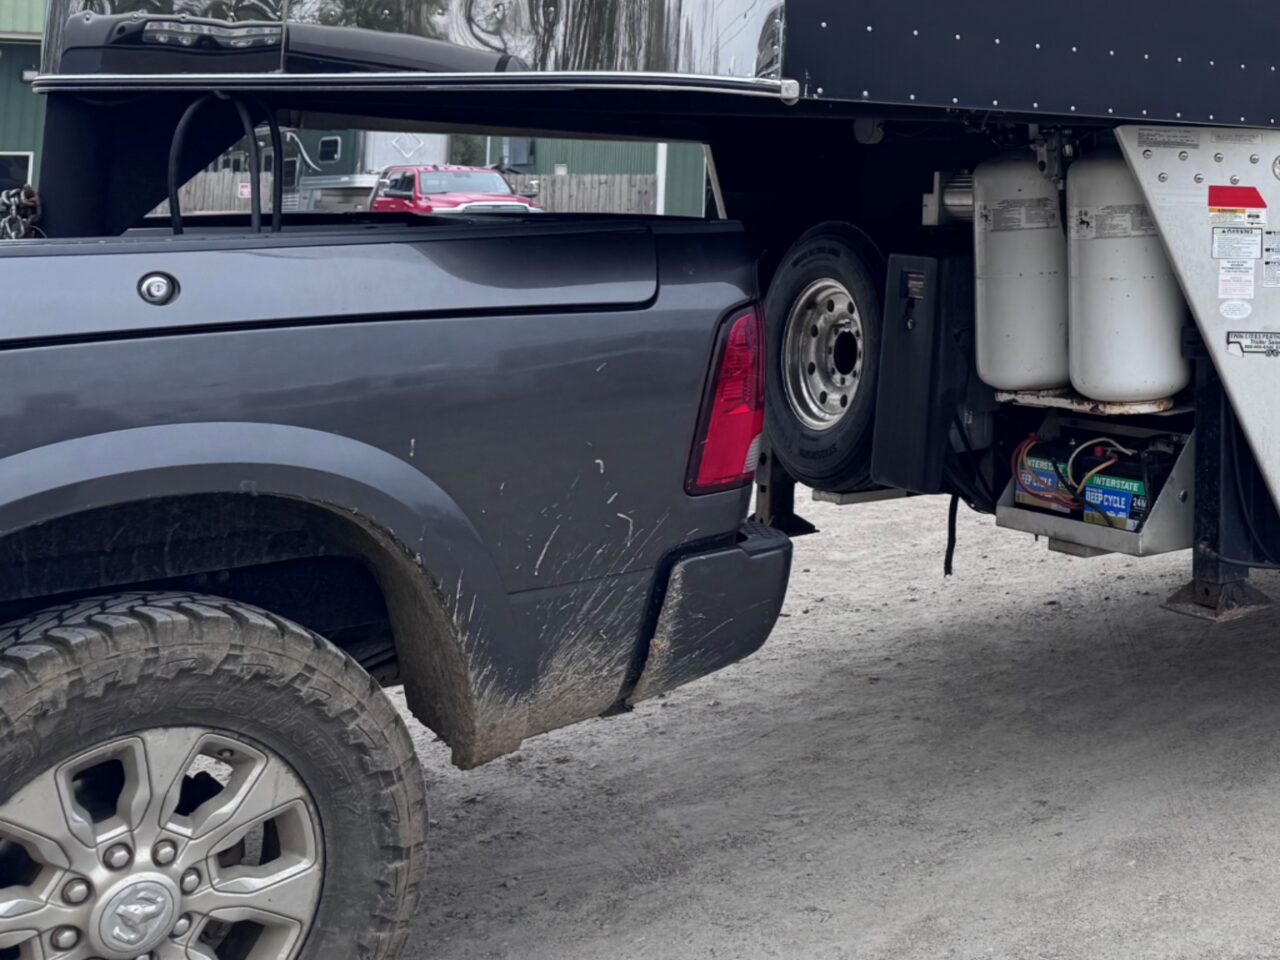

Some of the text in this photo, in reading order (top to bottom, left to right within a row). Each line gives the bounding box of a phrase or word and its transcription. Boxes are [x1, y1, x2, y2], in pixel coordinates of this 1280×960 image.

[1093, 475, 1140, 492] INTERSTATE
[1085, 490, 1127, 509] DEEP CYCLE
